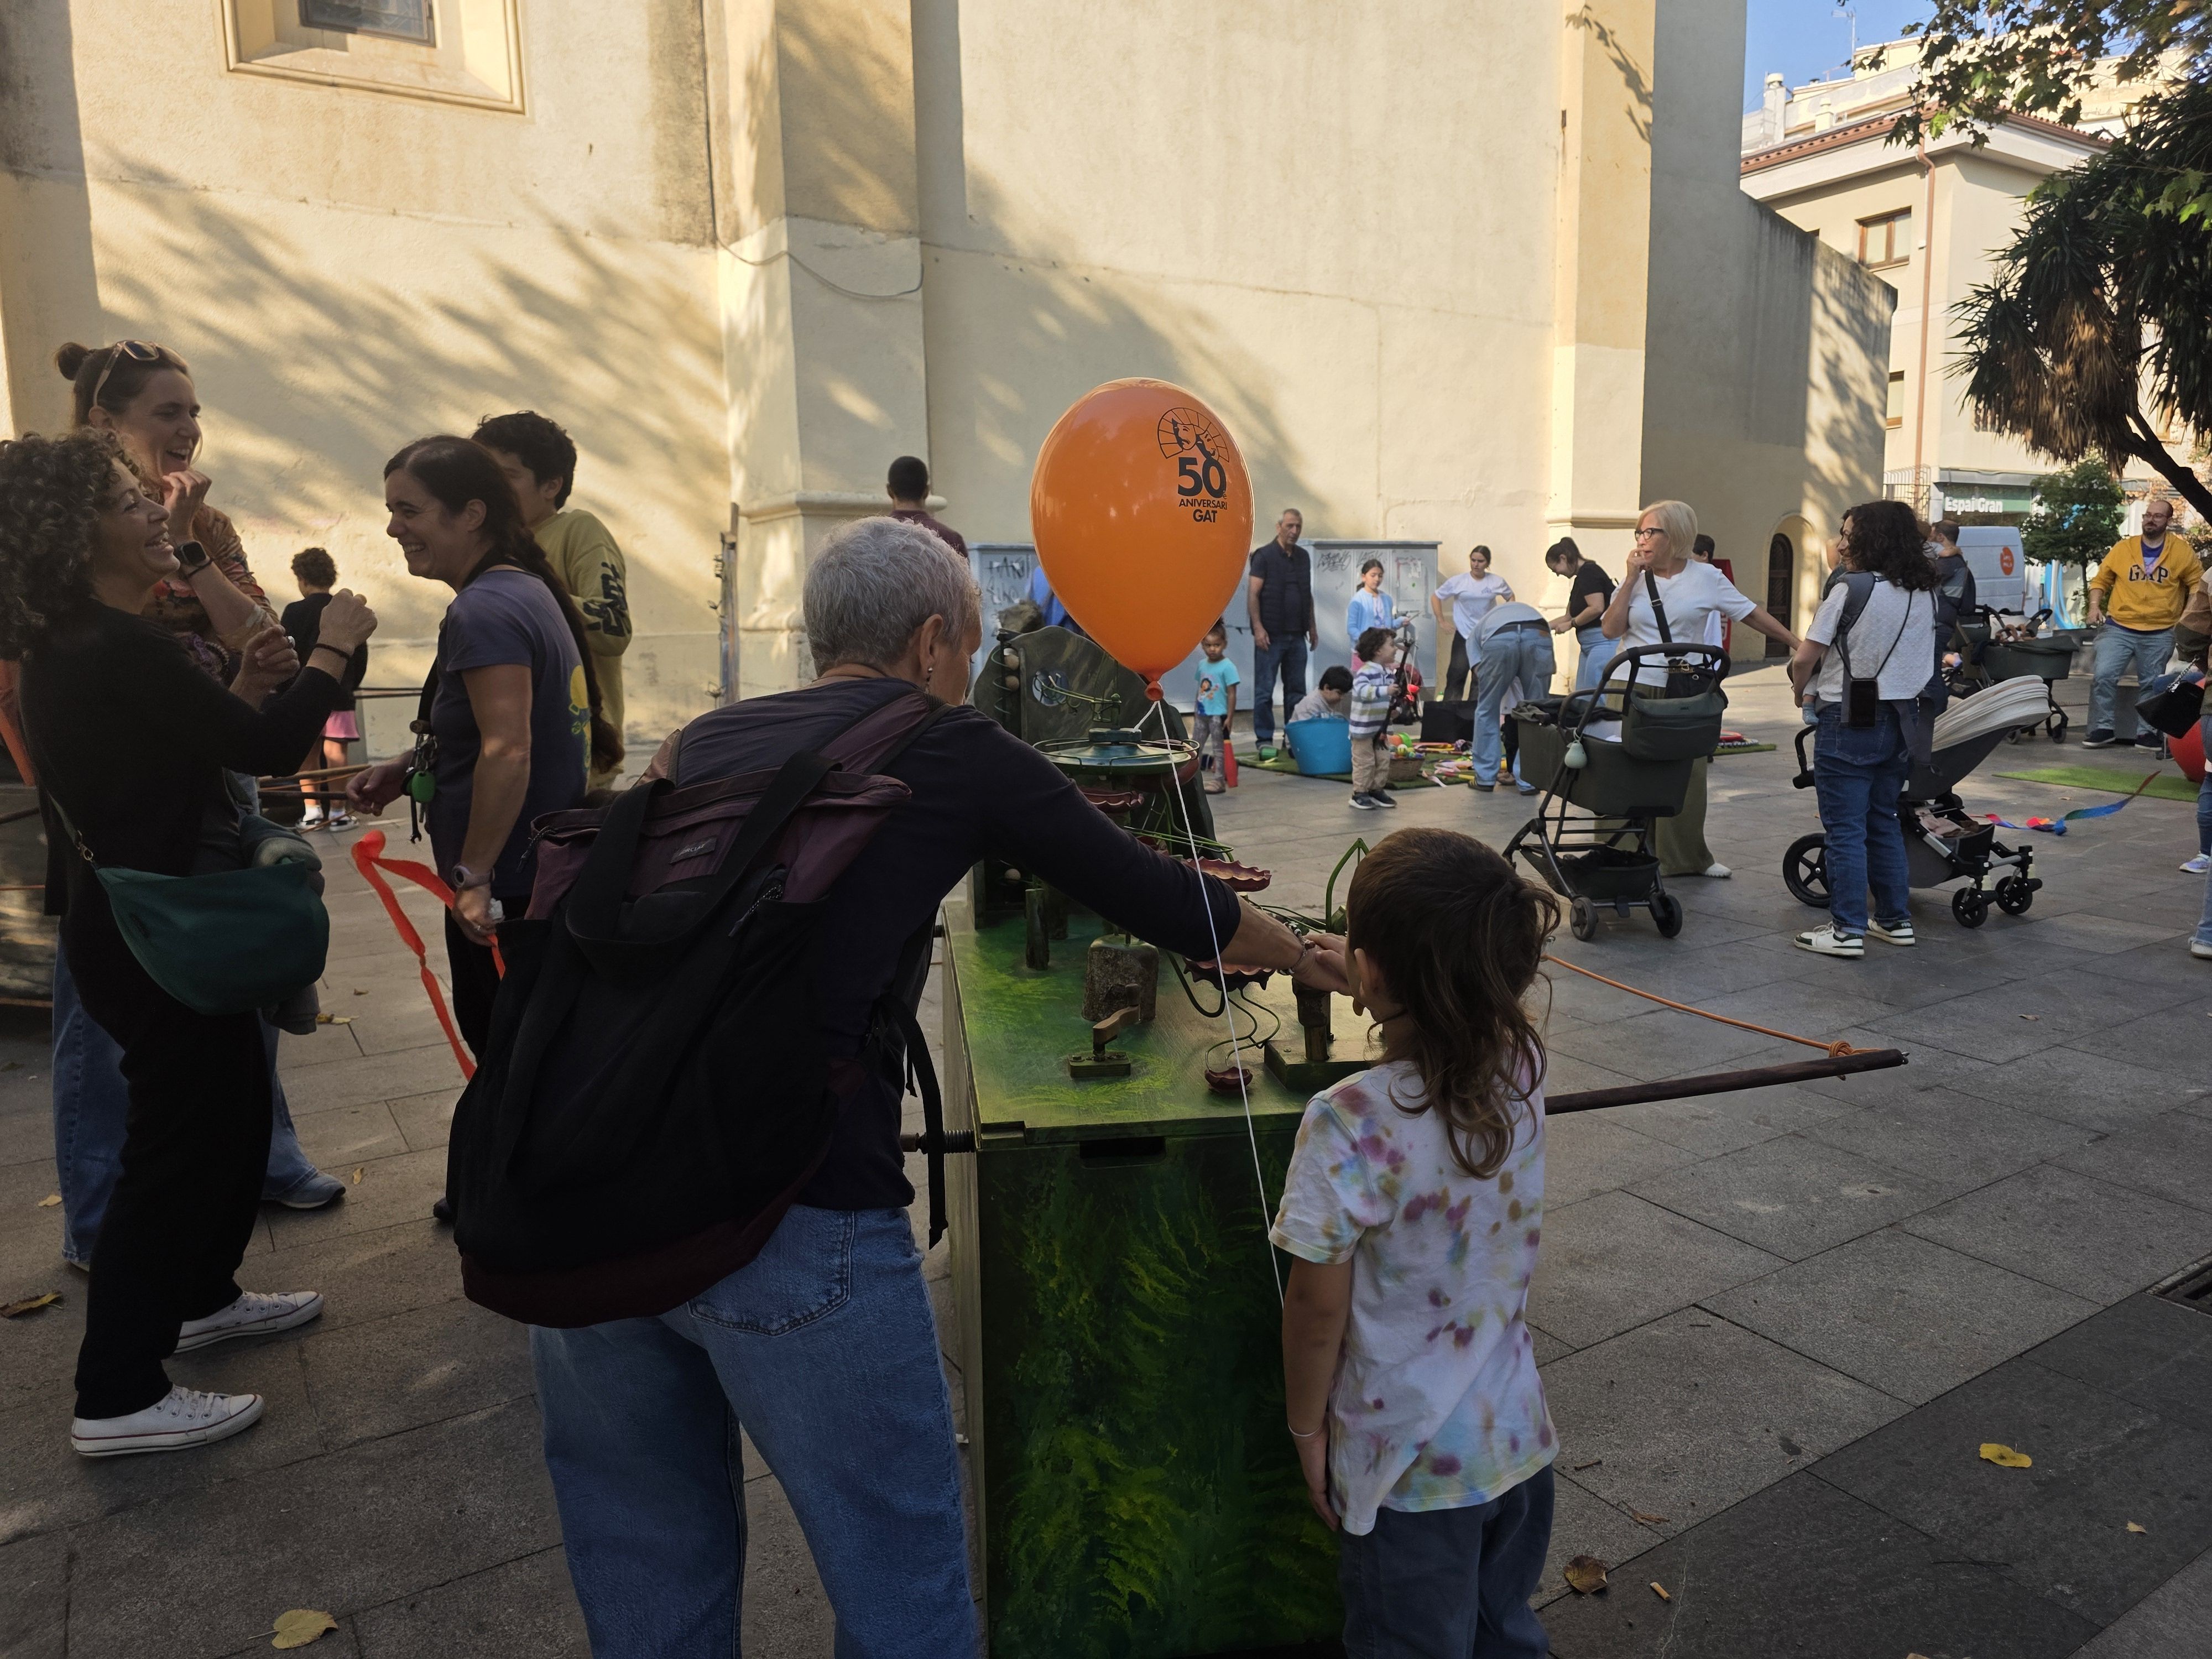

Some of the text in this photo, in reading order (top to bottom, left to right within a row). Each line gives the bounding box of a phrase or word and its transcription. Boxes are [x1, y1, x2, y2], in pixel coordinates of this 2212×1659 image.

[1178, 499, 1227, 510] ANIVERSARI
[1945, 496, 2003, 515] Espai Gran
[1193, 509, 1217, 523] GAT
